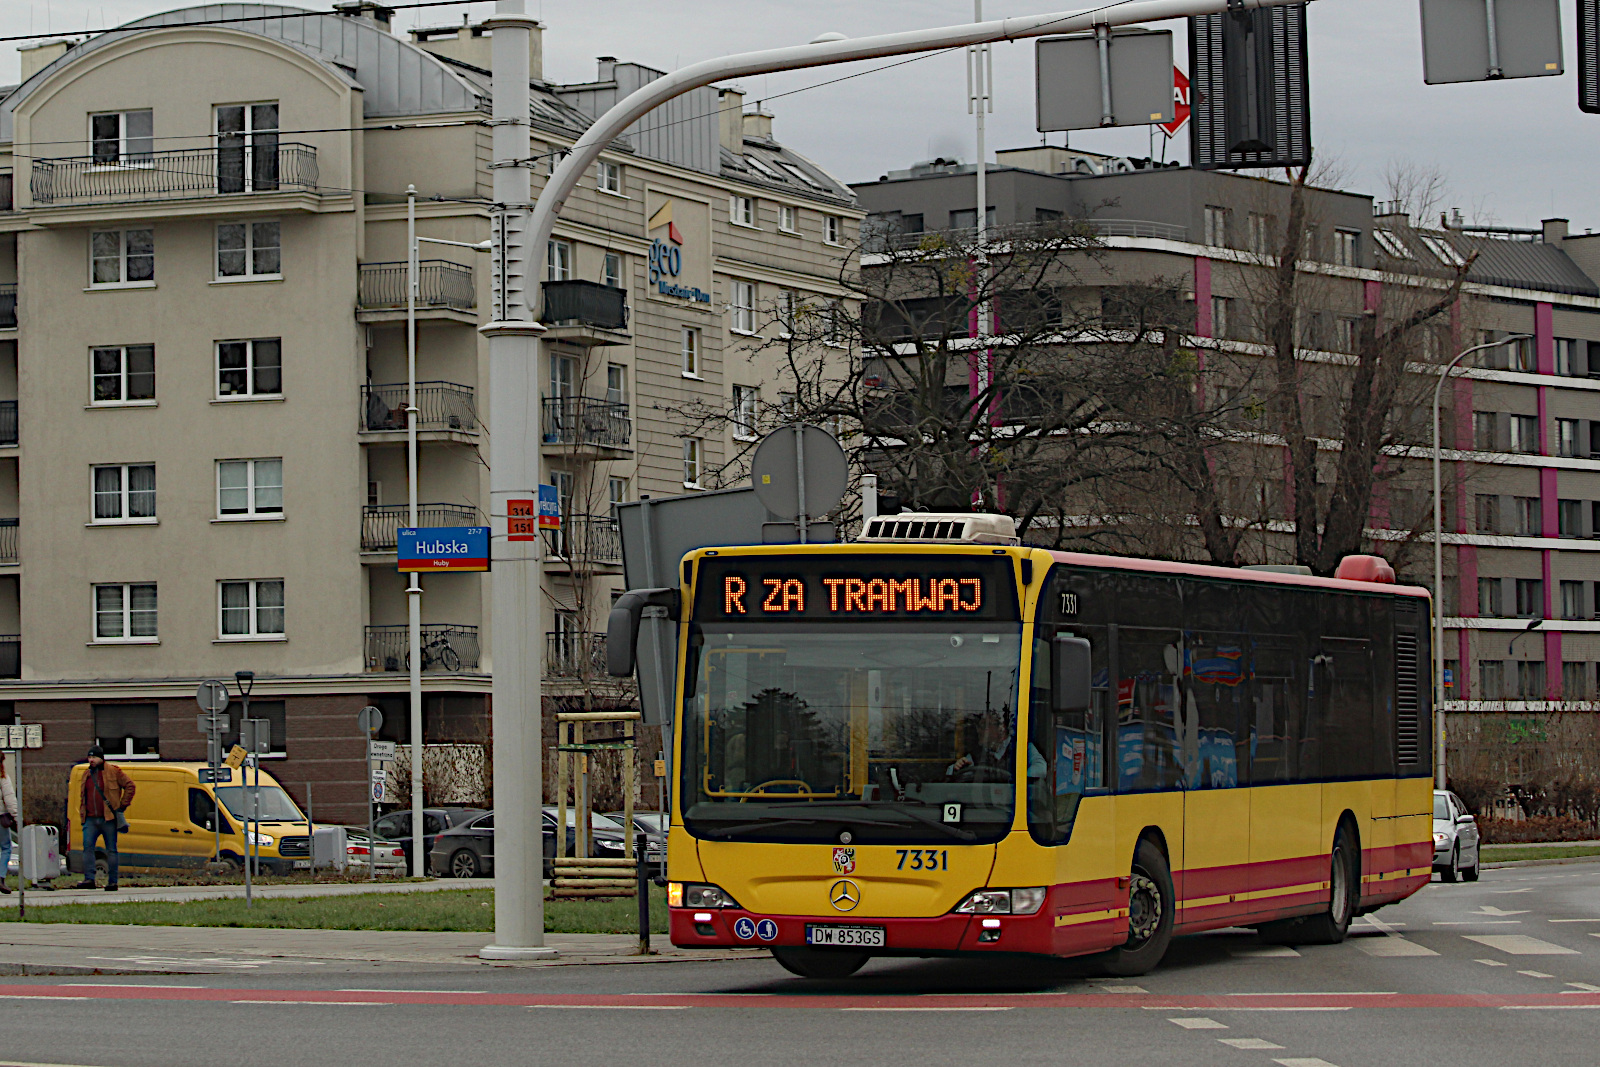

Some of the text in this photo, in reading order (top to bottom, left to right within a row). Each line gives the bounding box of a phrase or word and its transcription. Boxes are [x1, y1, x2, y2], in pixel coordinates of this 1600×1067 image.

[649, 238, 682, 285] geo
[512, 507, 531, 516] 314
[514, 524, 531, 532] 151
[416, 540, 468, 554] Hubska
[725, 576, 981, 613] R ZA TRAMWAJ
[1061, 593, 1077, 614] 7331
[947, 806, 957, 820] 9
[896, 849, 949, 871] 7331
[815, 928, 833, 942] DW
[838, 930, 881, 945] 853GS
